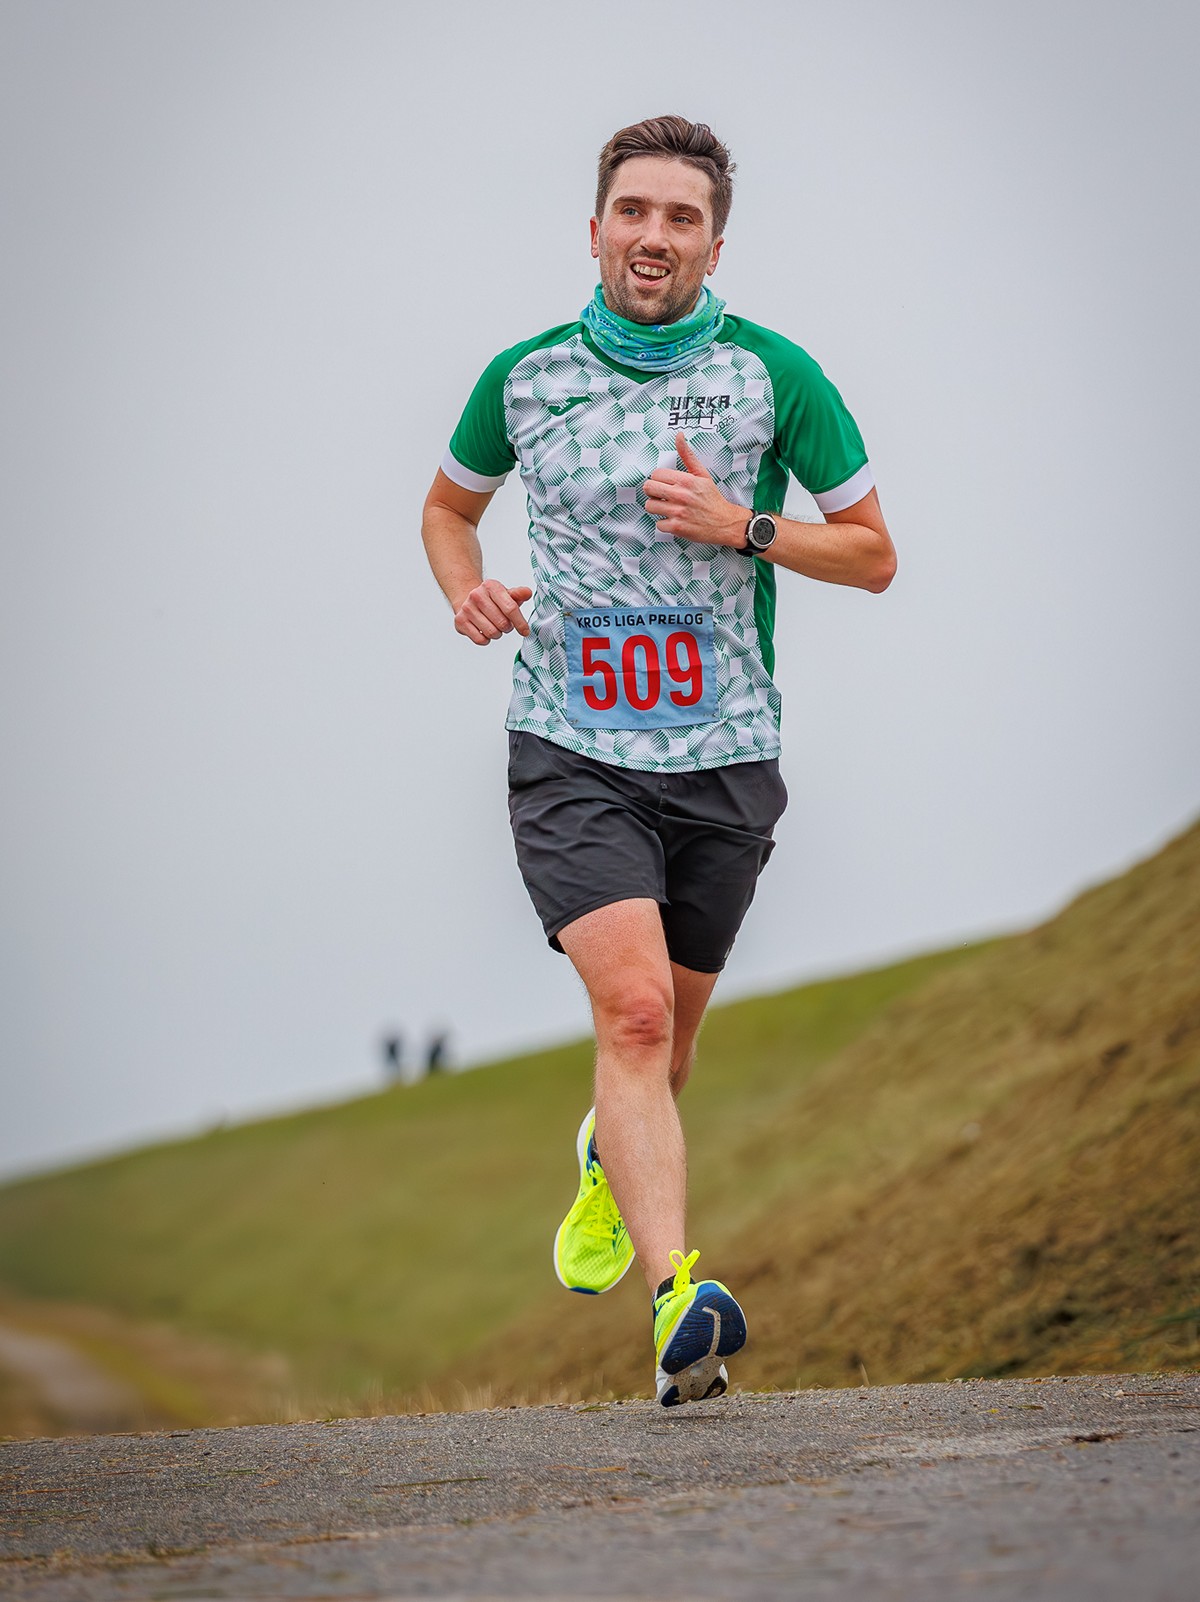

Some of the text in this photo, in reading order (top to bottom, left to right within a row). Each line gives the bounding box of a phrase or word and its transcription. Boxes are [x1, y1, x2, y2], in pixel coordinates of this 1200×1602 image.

[670, 394, 730, 410] UTRKA
[576, 613, 703, 629] KROS LIGA PRELOG
[582, 631, 703, 711] 509
